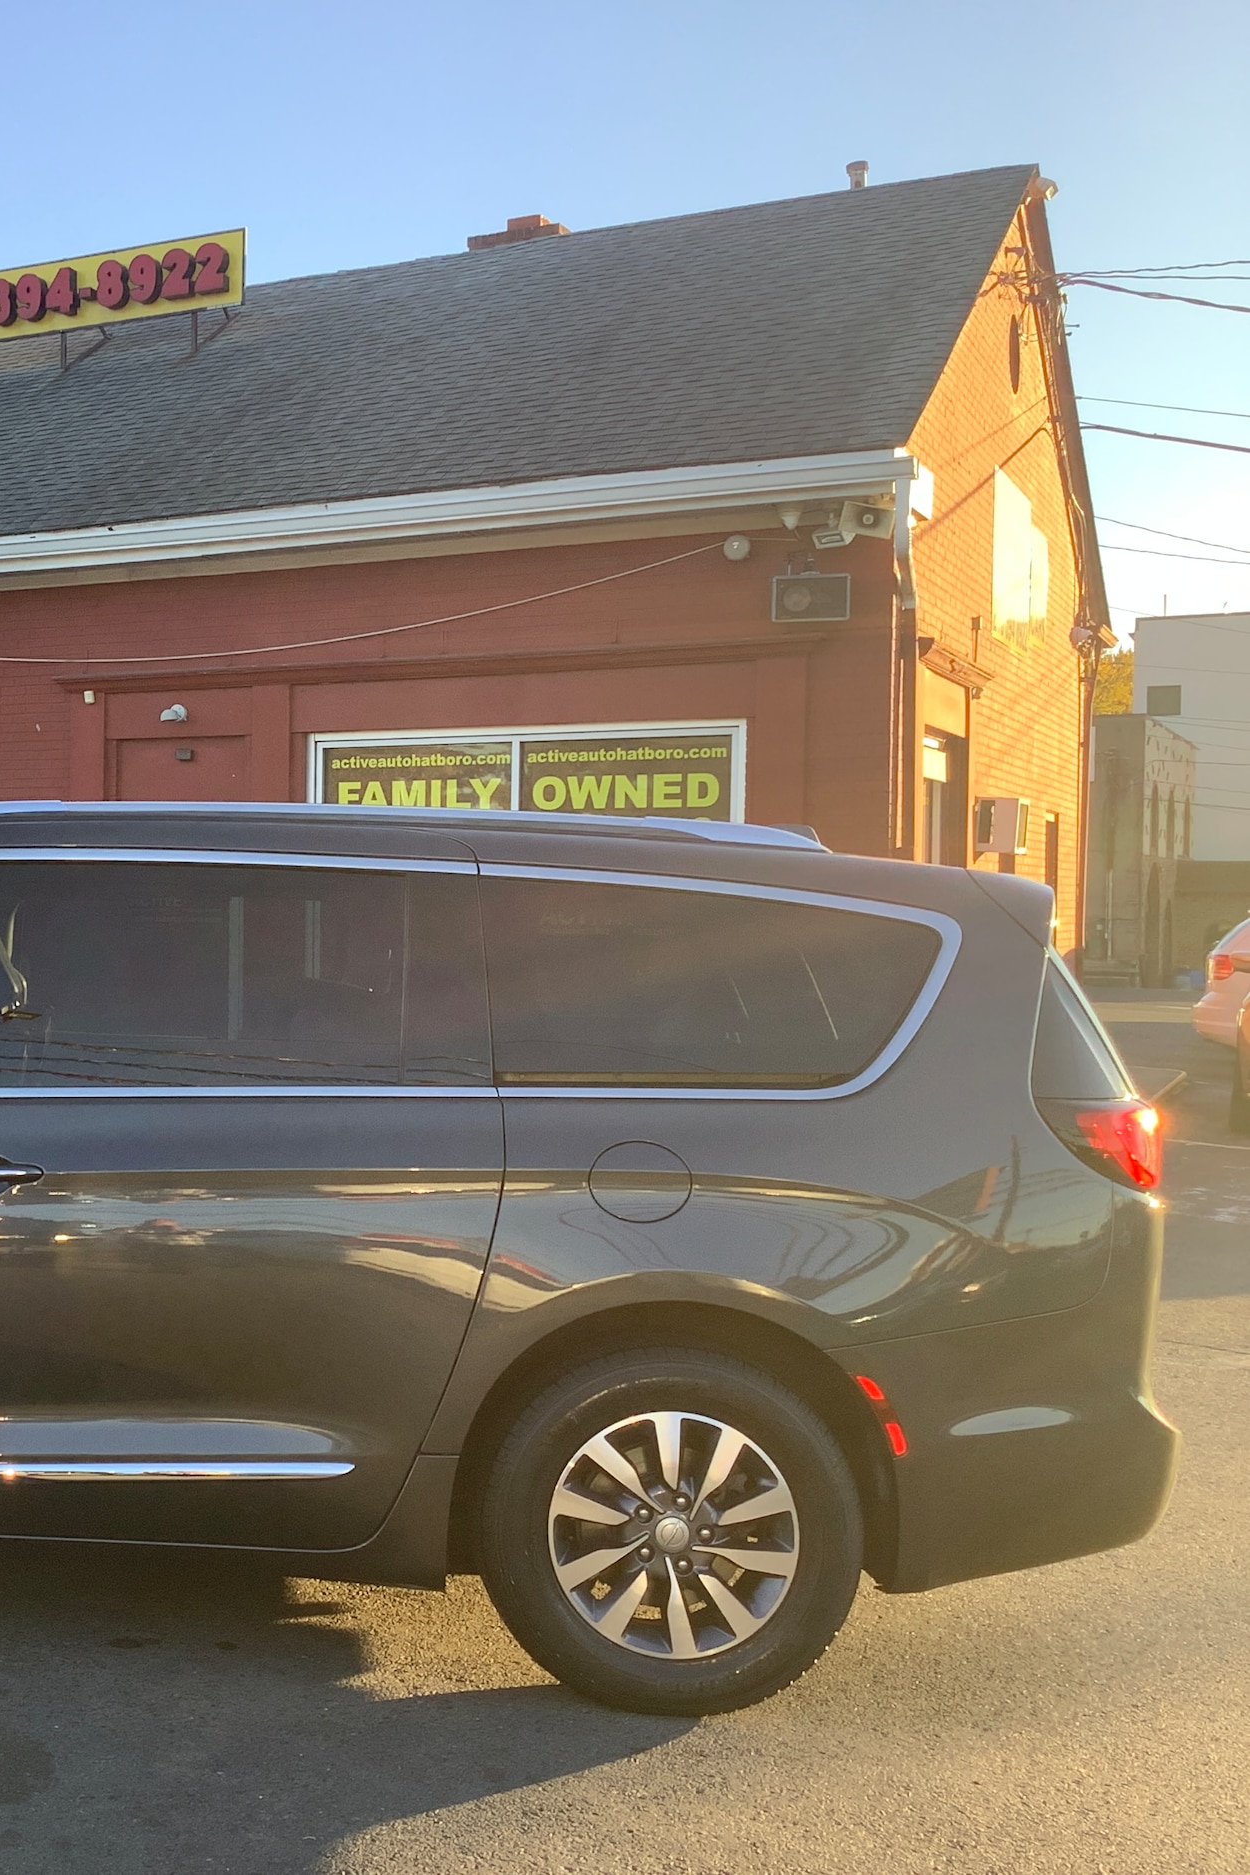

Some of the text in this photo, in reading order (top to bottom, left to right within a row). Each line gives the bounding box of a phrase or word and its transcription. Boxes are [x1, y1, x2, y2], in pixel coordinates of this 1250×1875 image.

[331, 753, 511, 769] activeautohatboro.com
[526, 746, 727, 764] activeautohatboro.com
[338, 772, 720, 811] FAMILY OWNED
